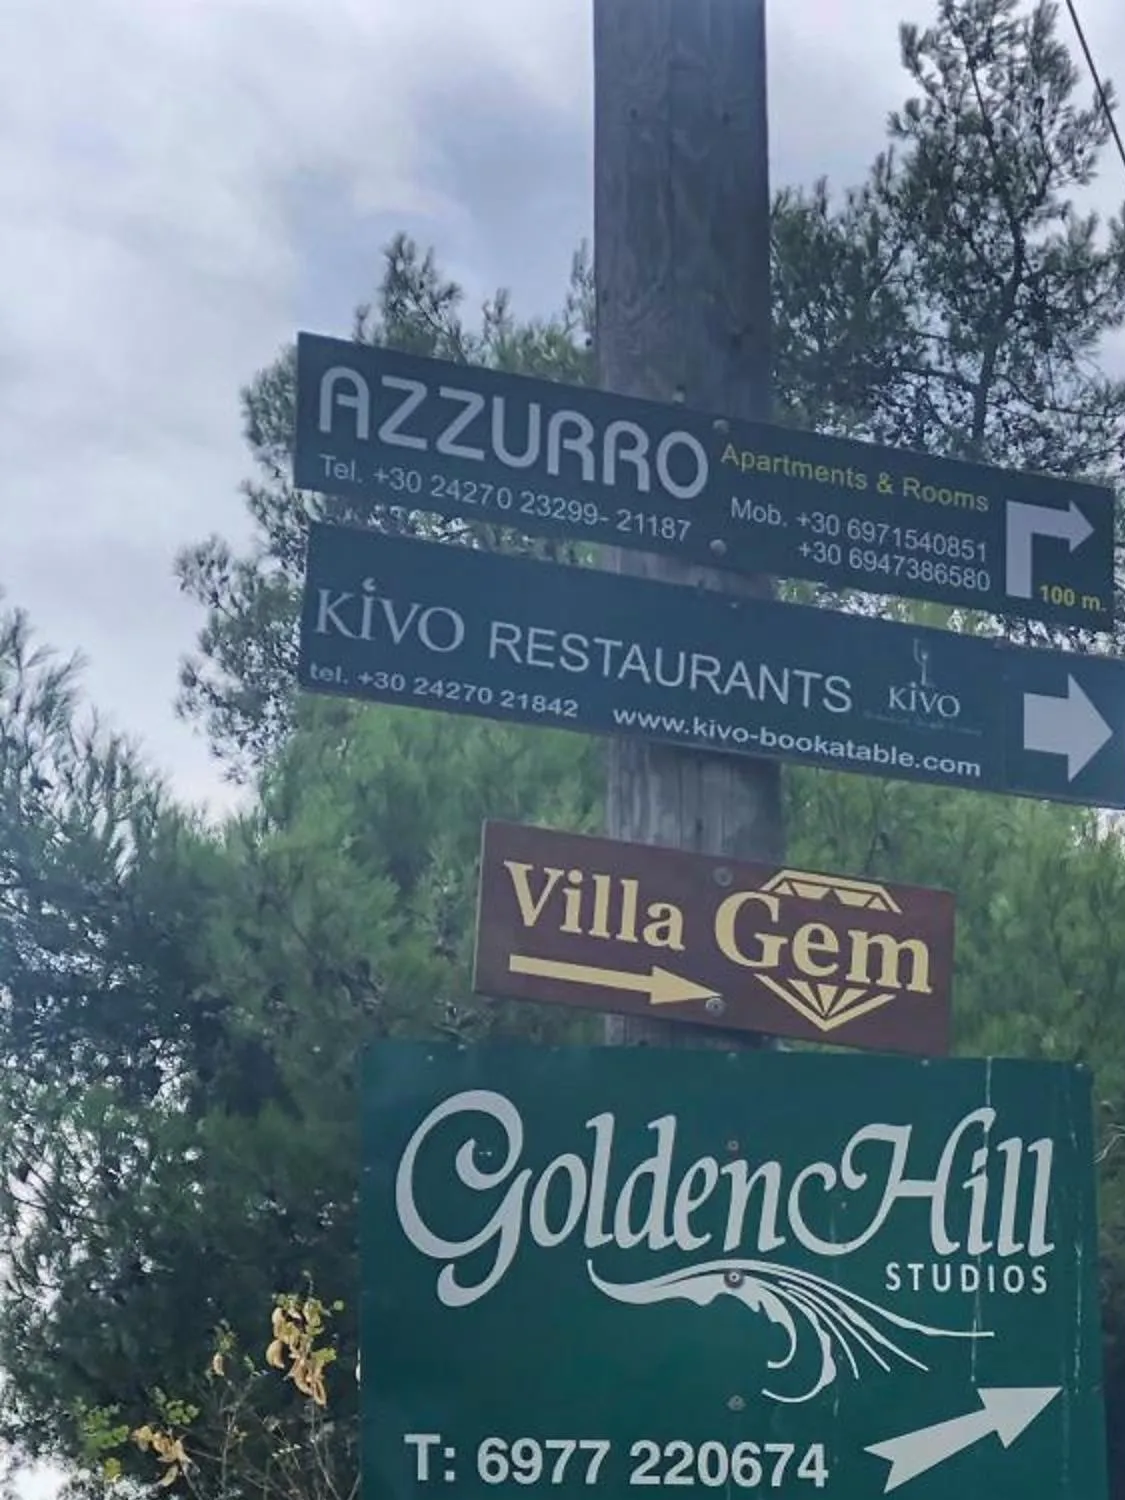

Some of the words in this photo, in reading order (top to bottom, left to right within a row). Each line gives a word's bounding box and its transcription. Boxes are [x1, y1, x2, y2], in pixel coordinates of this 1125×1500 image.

[318, 366, 708, 499] AZZURRO
[319, 454, 362, 483] Tel.
[373, 467, 422, 494] +30
[431, 475, 511, 509] 24270
[616, 509, 692, 542] 21187
[721, 443, 868, 491] Apartments
[876, 472, 894, 495] &
[903, 477, 989, 513] Rooms
[731, 497, 788, 527] Mob.
[796, 511, 840, 537] +30
[848, 513, 987, 562] 6971540851
[799, 542, 841, 566] +30
[849, 544, 991, 592] 6947386580
[1039, 584, 1075, 607] 100
[309, 662, 348, 685] tel.
[358, 670, 405, 692] +30
[412, 676, 492, 704] 24270
[501, 688, 579, 718] 21842
[488, 621, 853, 714] RESTAURANTS
[613, 708, 981, 778] www.kivo-bookatable.com
[503, 859, 686, 951] Villa
[714, 890, 933, 994] Gem
[885, 1262, 1048, 1294] STUDIOS
[403, 1433, 456, 1482] T:
[476, 1437, 611, 1485] 6977
[629, 1440, 829, 1488] 220674
